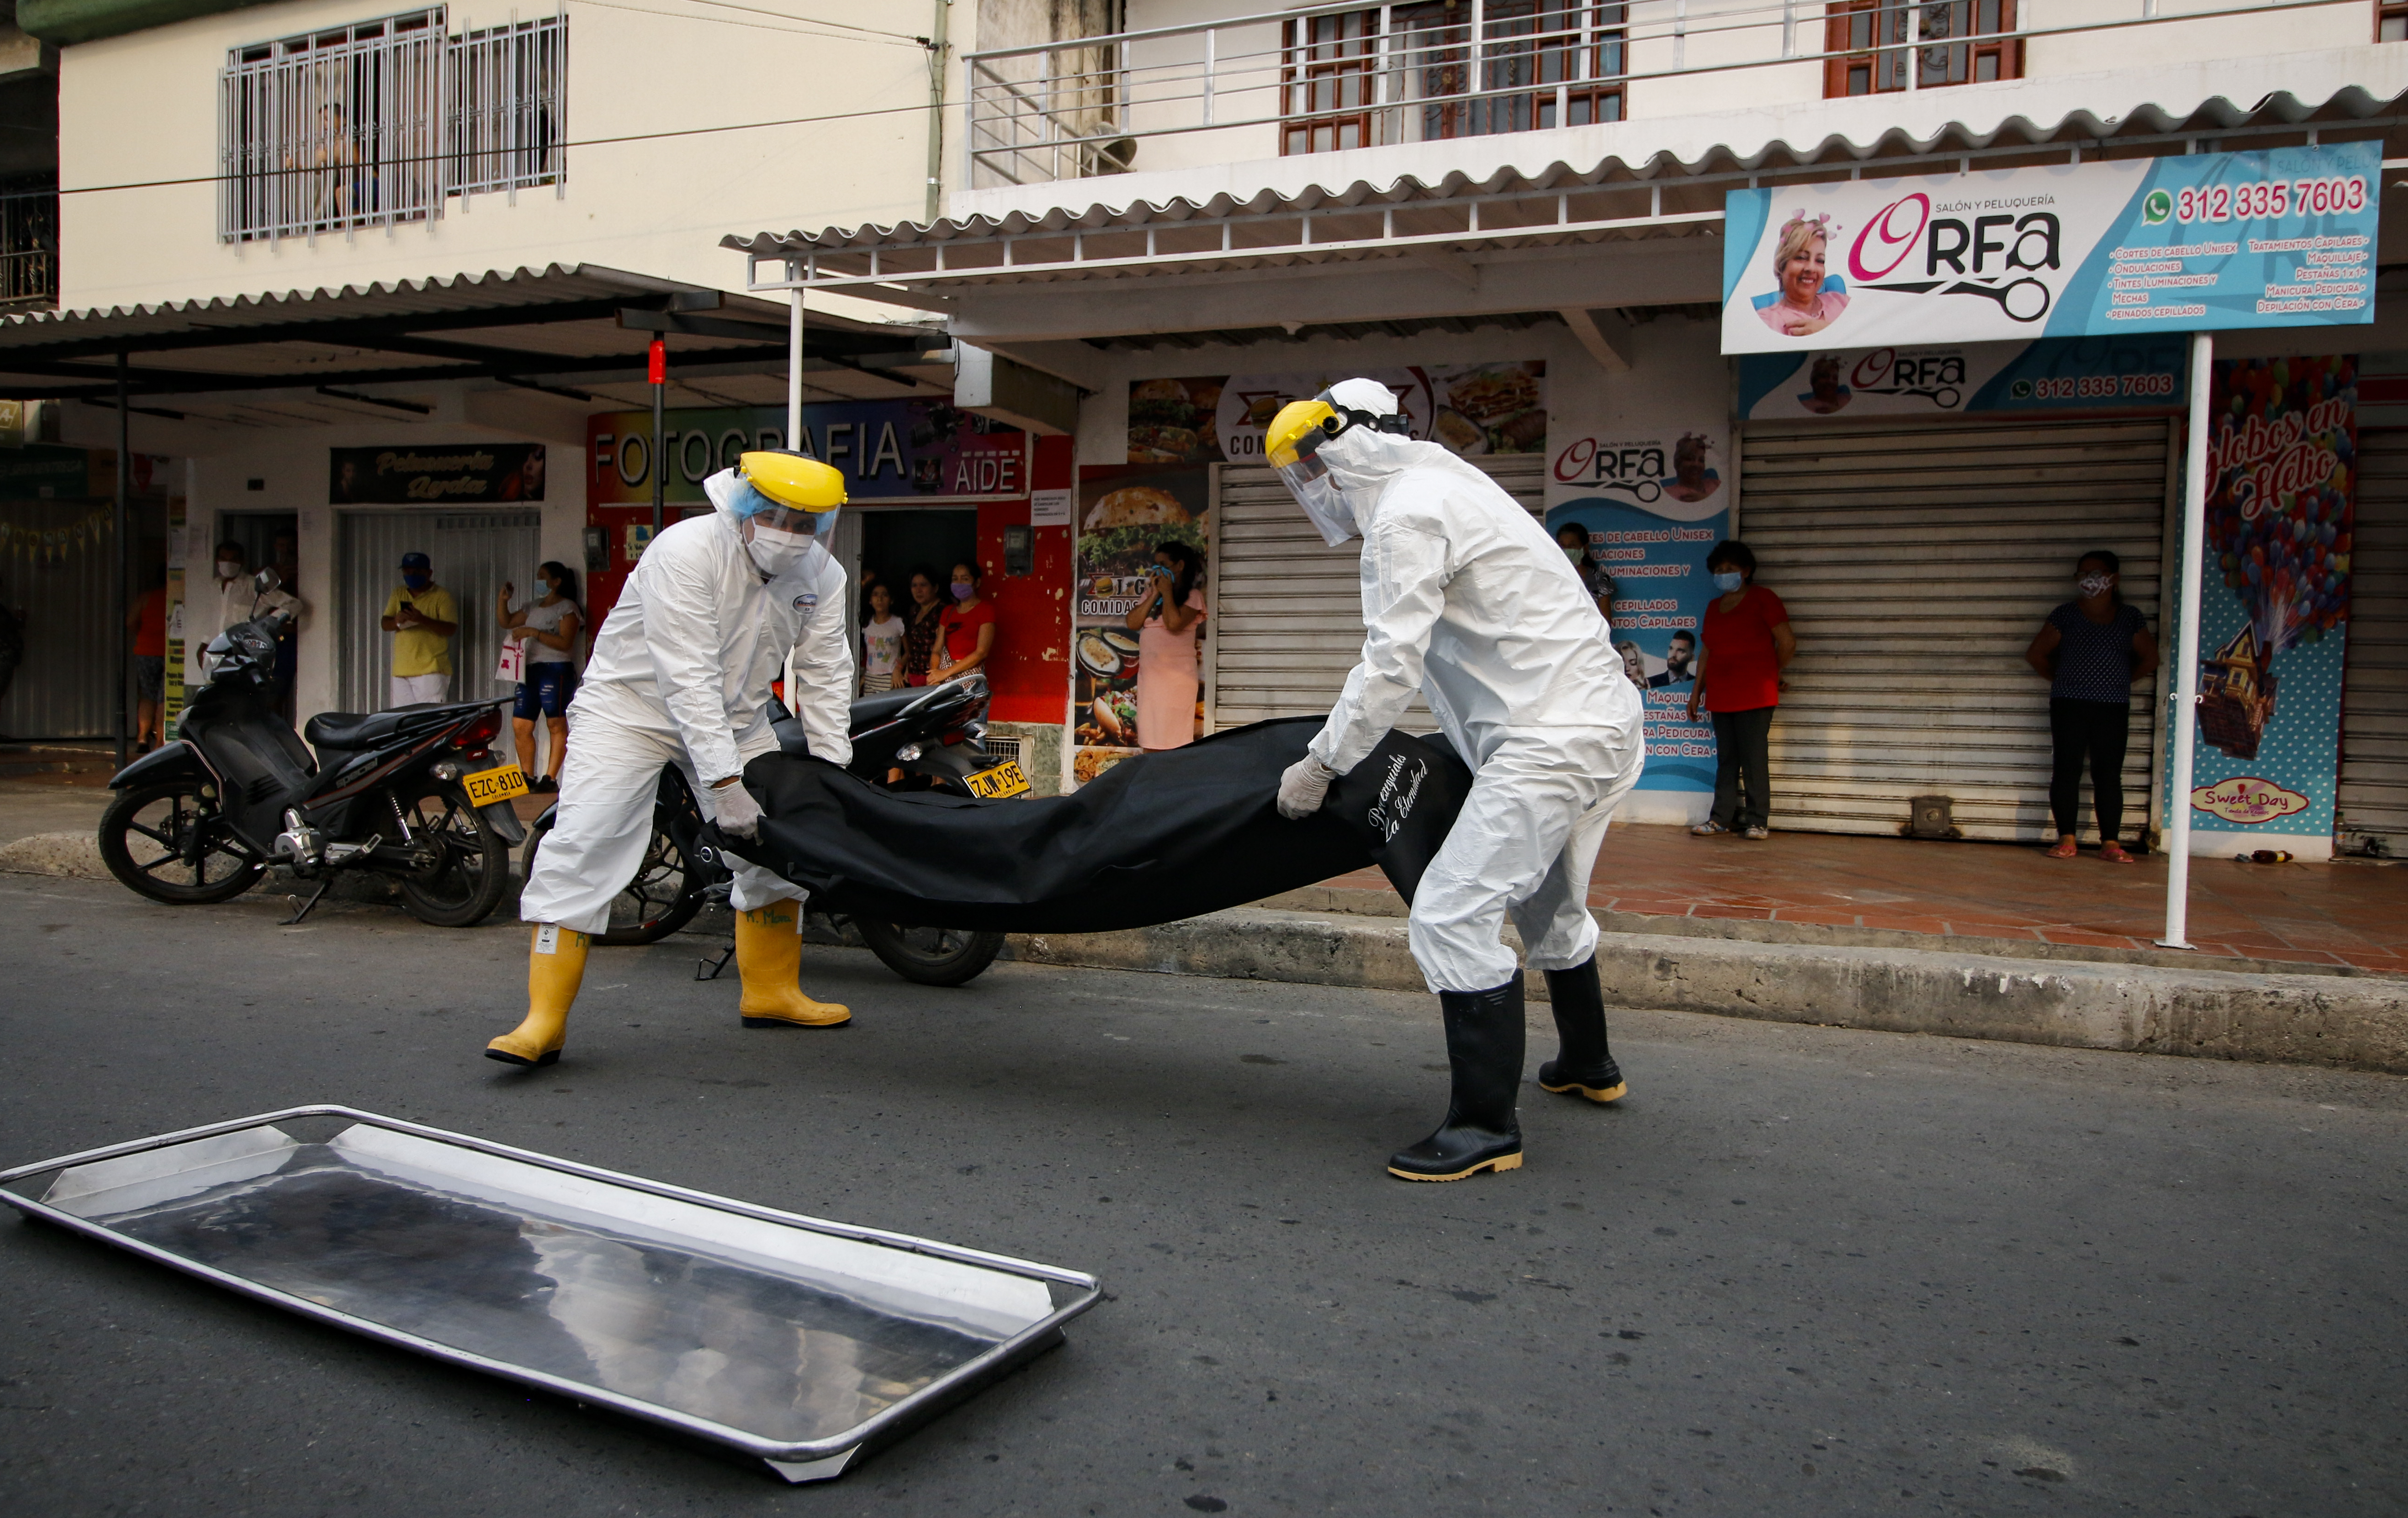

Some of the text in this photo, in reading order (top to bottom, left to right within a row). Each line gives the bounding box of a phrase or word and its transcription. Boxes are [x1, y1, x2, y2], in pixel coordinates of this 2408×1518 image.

[1935, 193, 2055, 213] SALÓN Y PELUQUERÍA
[2177, 178, 2365, 222] 312 335 7603
[2248, 236, 2363, 252] TRATAMIENTOS CAPILARES
[2306, 252, 2361, 264] MAQUILLAJE
[2114, 261, 2181, 275] ONDULACIONES
[2114, 275, 2217, 289] TINTES ILUMINACIONES Y
[2266, 282, 2359, 297] MANICURA PEDICURA
[2112, 293, 2148, 304] MECHAS
[2111, 305, 2205, 319] PEINADOS CEPILLADOS
[2036, 375, 2173, 398] 312 335 7603
[2307, 397, 2349, 435] en
[2234, 441, 2338, 519] Helio
[1683, 565, 1690, 575] Y
[1614, 600, 1677, 611] CEPILLADOS
[1639, 615, 1696, 627] CAPILARES
[1644, 708, 1686, 721] ESTAÑAS
[1658, 726, 1710, 738] PEDICURA
[997, 765, 1025, 789] 19E
[469, 771, 523, 799] EZC 81D
[1385, 758, 1428, 843] La Eternidad
[2204, 791, 2288, 810] Sweet Day
